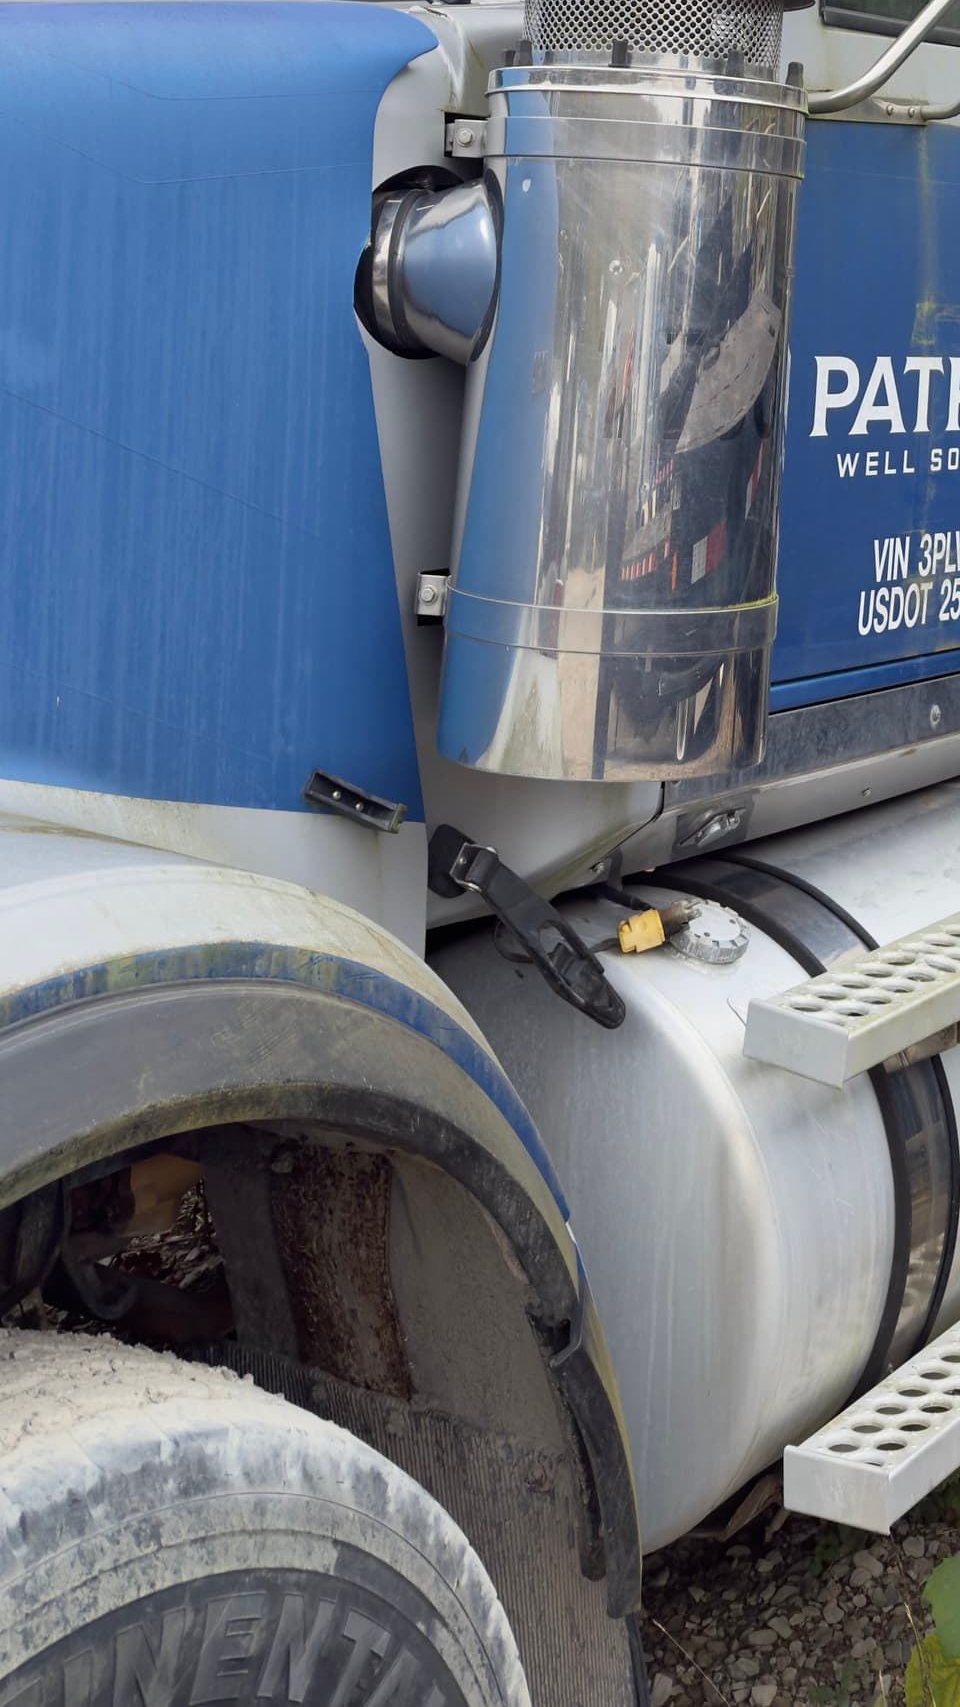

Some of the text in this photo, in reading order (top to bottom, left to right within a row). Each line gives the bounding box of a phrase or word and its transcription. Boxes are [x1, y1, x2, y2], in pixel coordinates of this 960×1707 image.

[836, 449, 915, 478] WELL
[874, 536, 910, 582] VIN
[858, 581, 933, 636] USDOT
